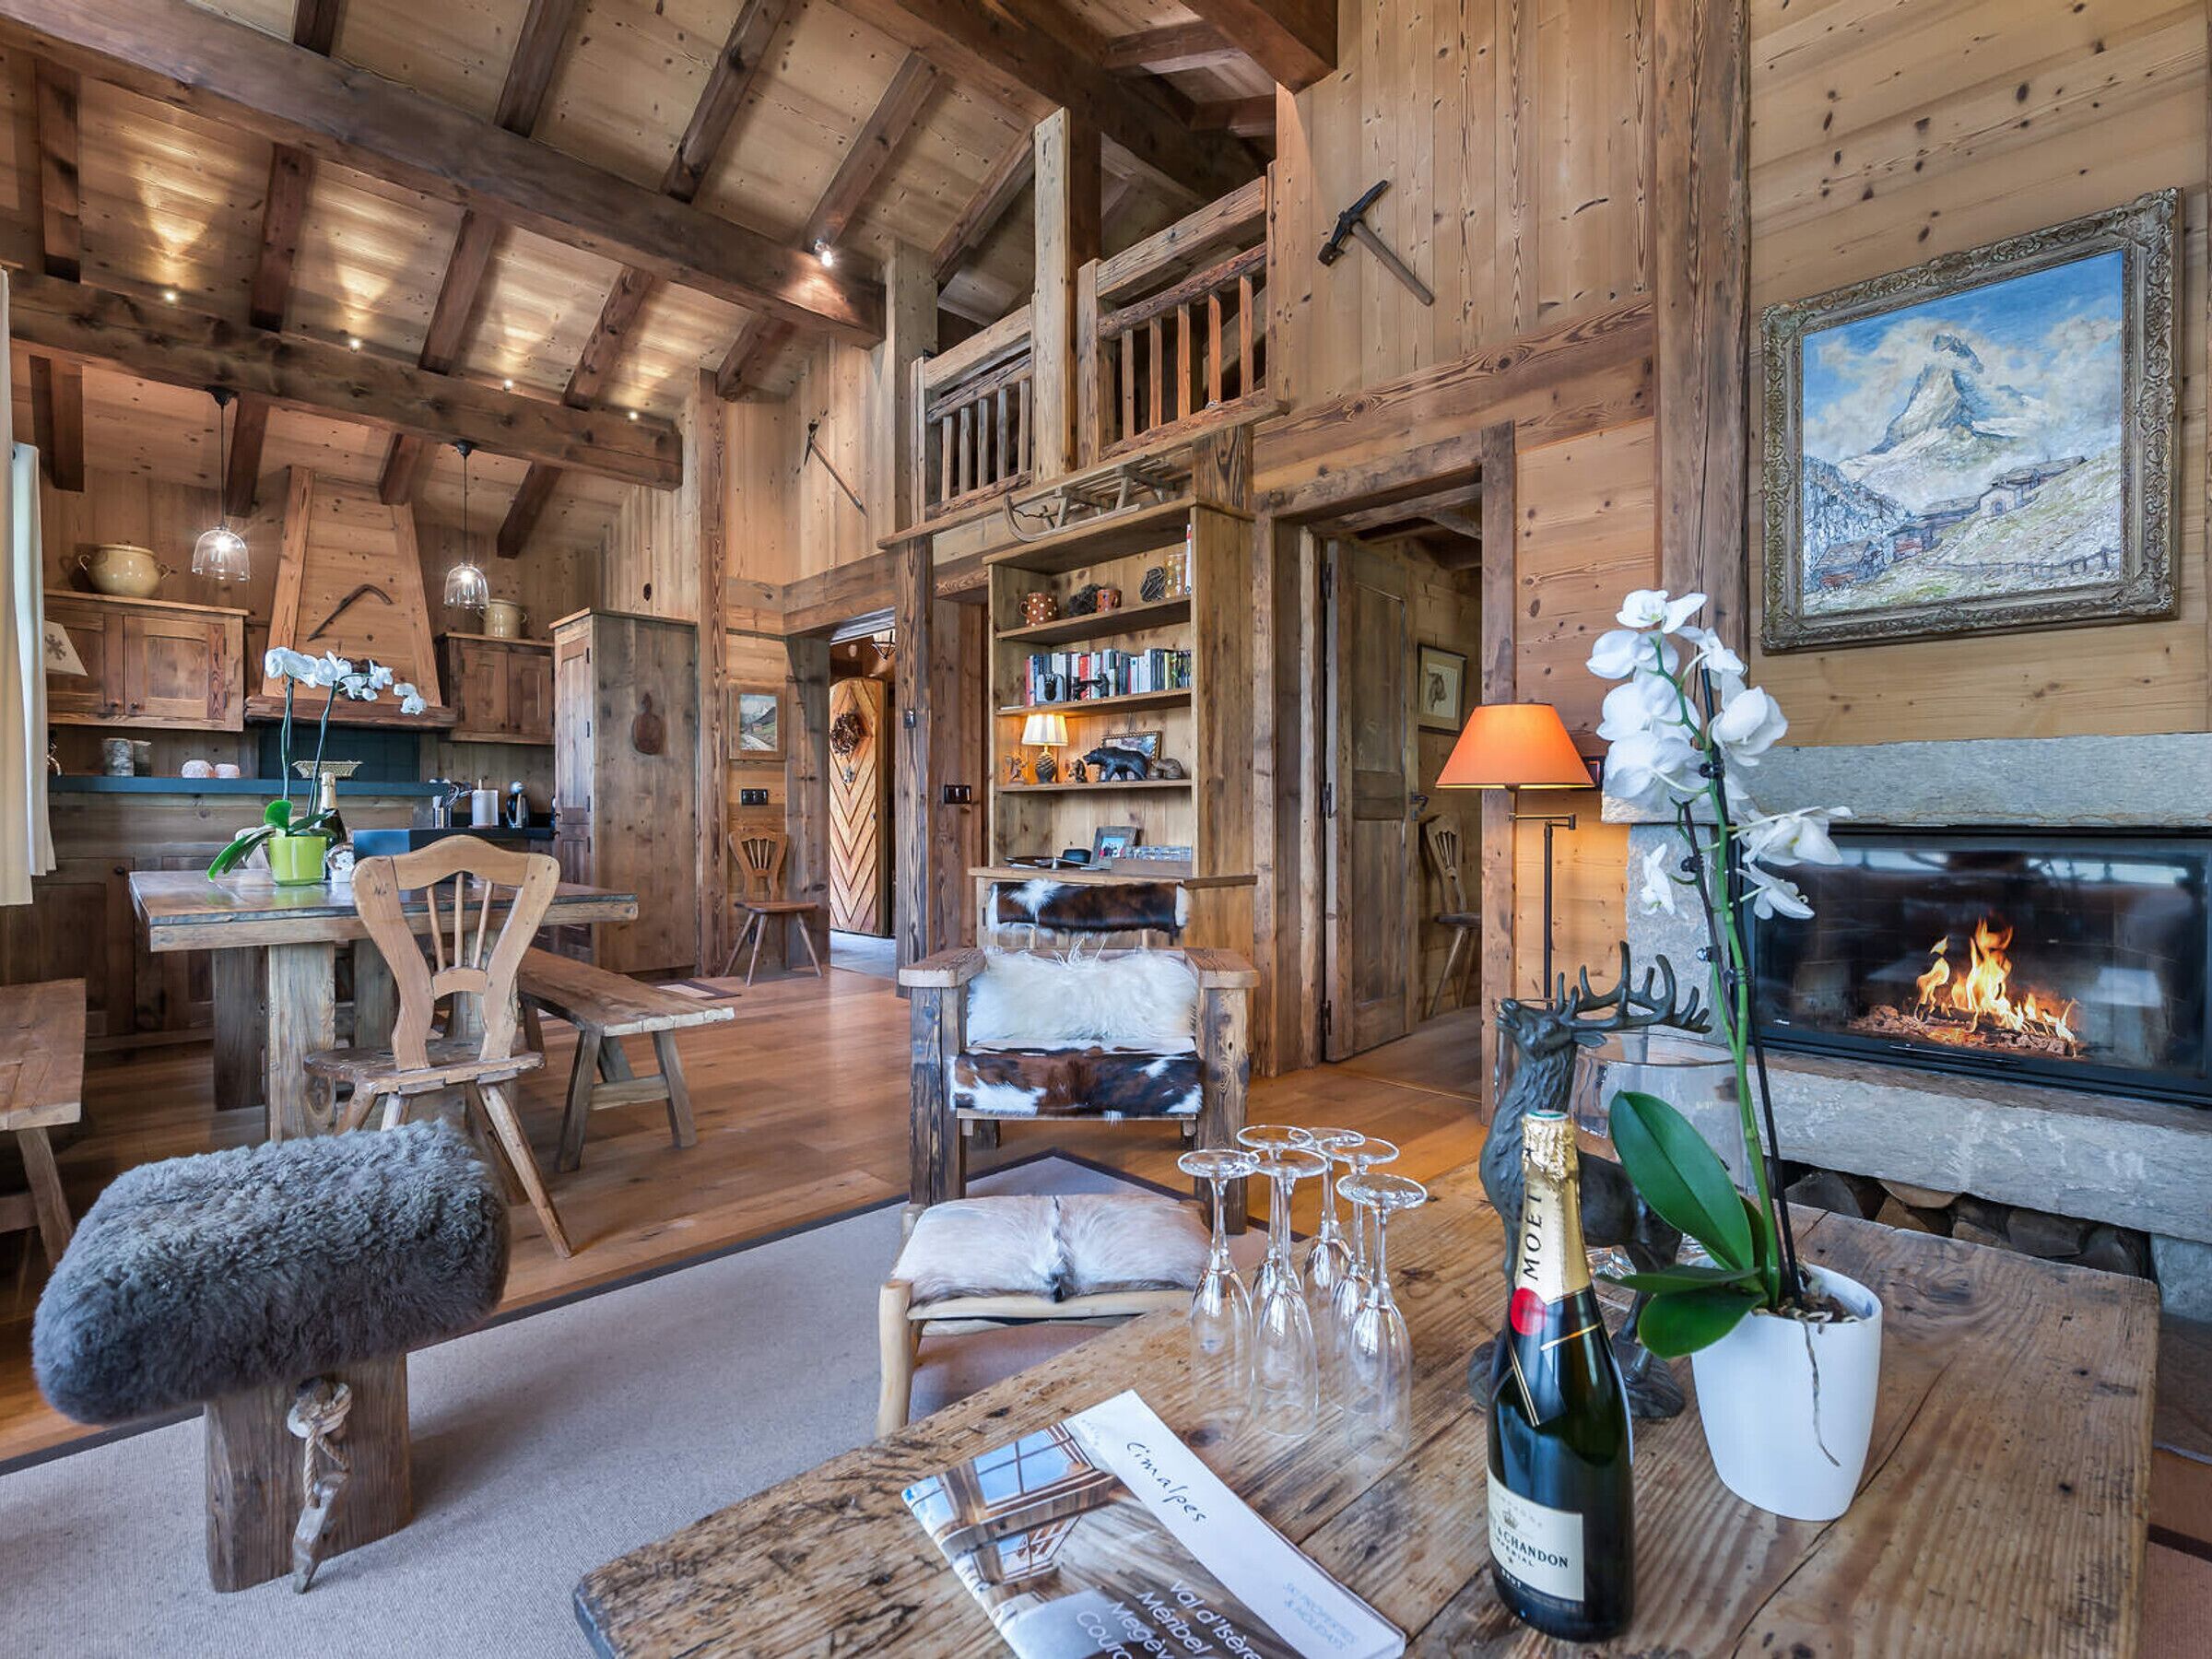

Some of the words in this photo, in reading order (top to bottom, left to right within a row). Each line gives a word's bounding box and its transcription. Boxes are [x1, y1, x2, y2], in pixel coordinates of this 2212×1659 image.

[1126, 1441, 1207, 1523] Cimalpes
[1495, 1535, 1535, 1568] MPERIAL
[1503, 1531, 1569, 1569] CHANDON
[1170, 1579, 1206, 1609] Val
[1136, 1590, 1214, 1655] Méribel
